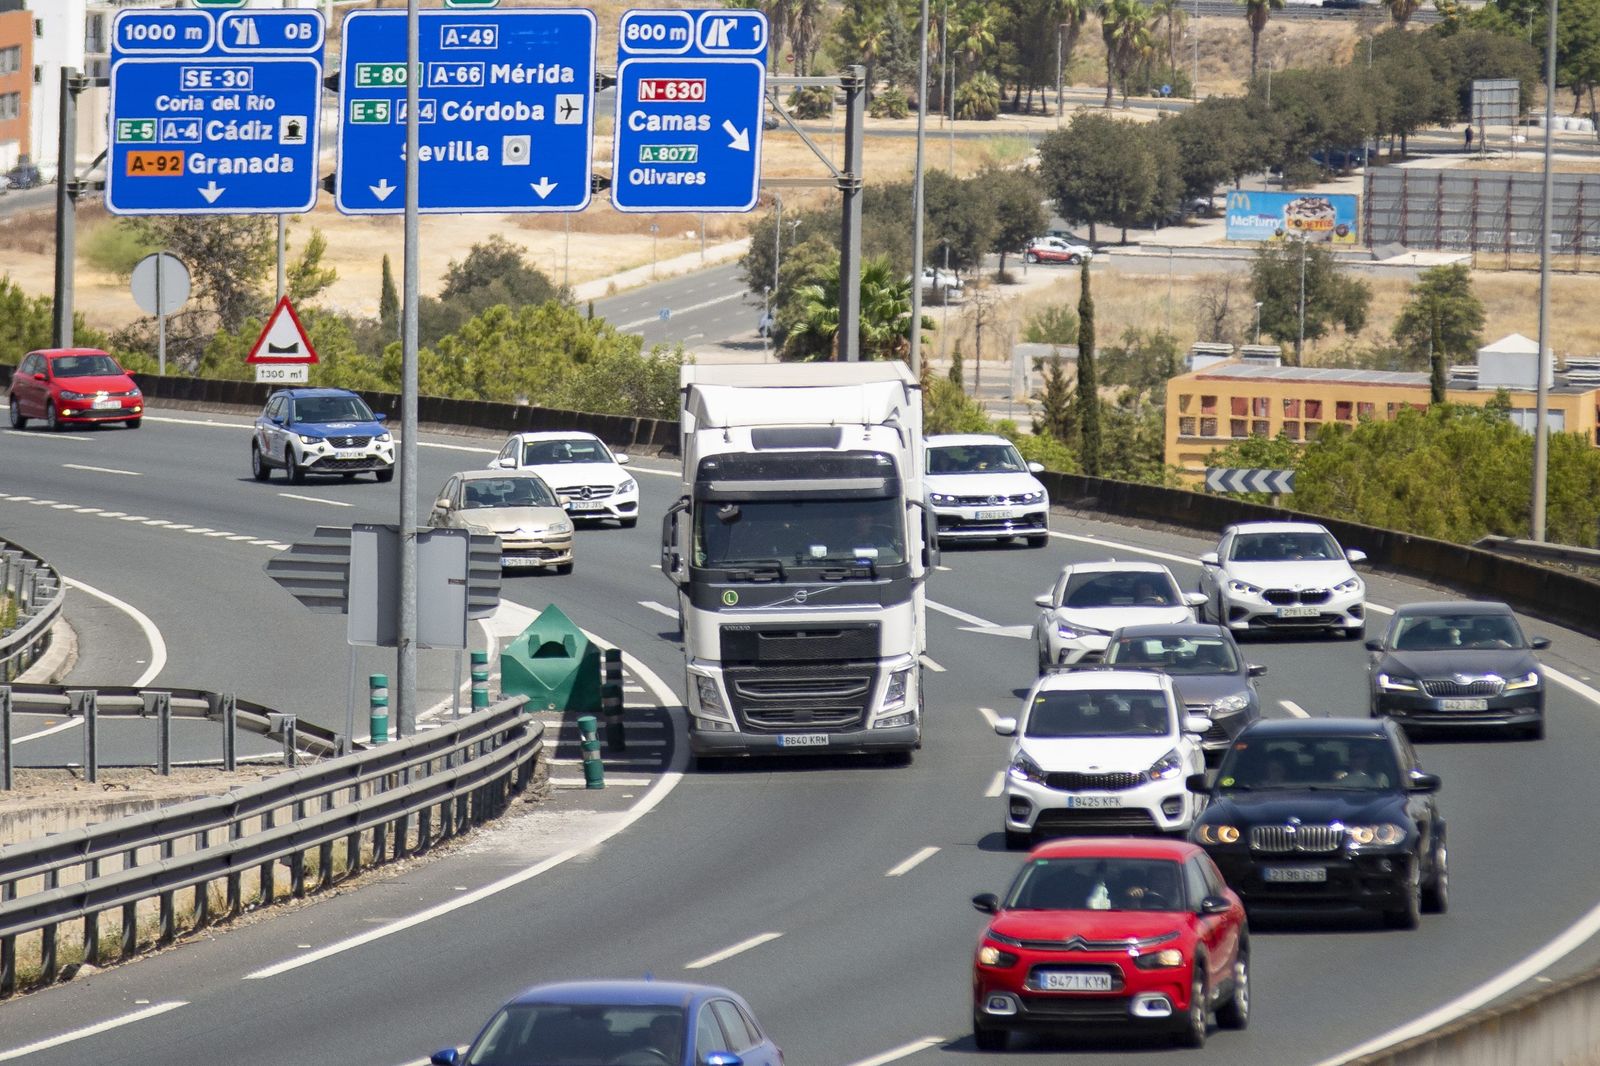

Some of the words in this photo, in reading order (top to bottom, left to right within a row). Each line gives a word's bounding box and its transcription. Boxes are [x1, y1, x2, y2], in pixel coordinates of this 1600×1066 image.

[125, 24, 176, 40] 1000
[184, 26, 202, 40] m
[445, 28, 494, 45] A-49
[628, 24, 665, 40] 800
[670, 27, 686, 41] m
[752, 26, 760, 41] 1
[184, 70, 250, 88] SE-30
[360, 66, 409, 83] E-80
[434, 66, 481, 83] A-66
[490, 64, 574, 84] Mérida
[642, 82, 703, 100] N-630
[156, 96, 204, 111] Coria
[211, 95, 240, 110] del
[246, 94, 276, 110] Río
[354, 104, 386, 120] E-5
[399, 104, 433, 120] A4
[442, 100, 544, 122] Córdoba
[628, 110, 712, 132] Camas
[119, 123, 154, 139] E-5
[164, 122, 198, 138] A-4
[206, 120, 272, 141] Cádiz
[642, 148, 696, 162] A-8077
[132, 155, 180, 172] A-92
[188, 154, 294, 174] Granada
[630, 169, 706, 186] Olivares
[1231, 215, 1281, 228] McFlurry
[261, 370, 284, 378] 1300
[785, 736, 808, 744] 6640
[810, 736, 826, 744] KRM
[1075, 797, 1099, 806] 9425
[1103, 796, 1120, 806] KFK
[1050, 976, 1080, 988] 9471
[1086, 976, 1109, 988] KYM
